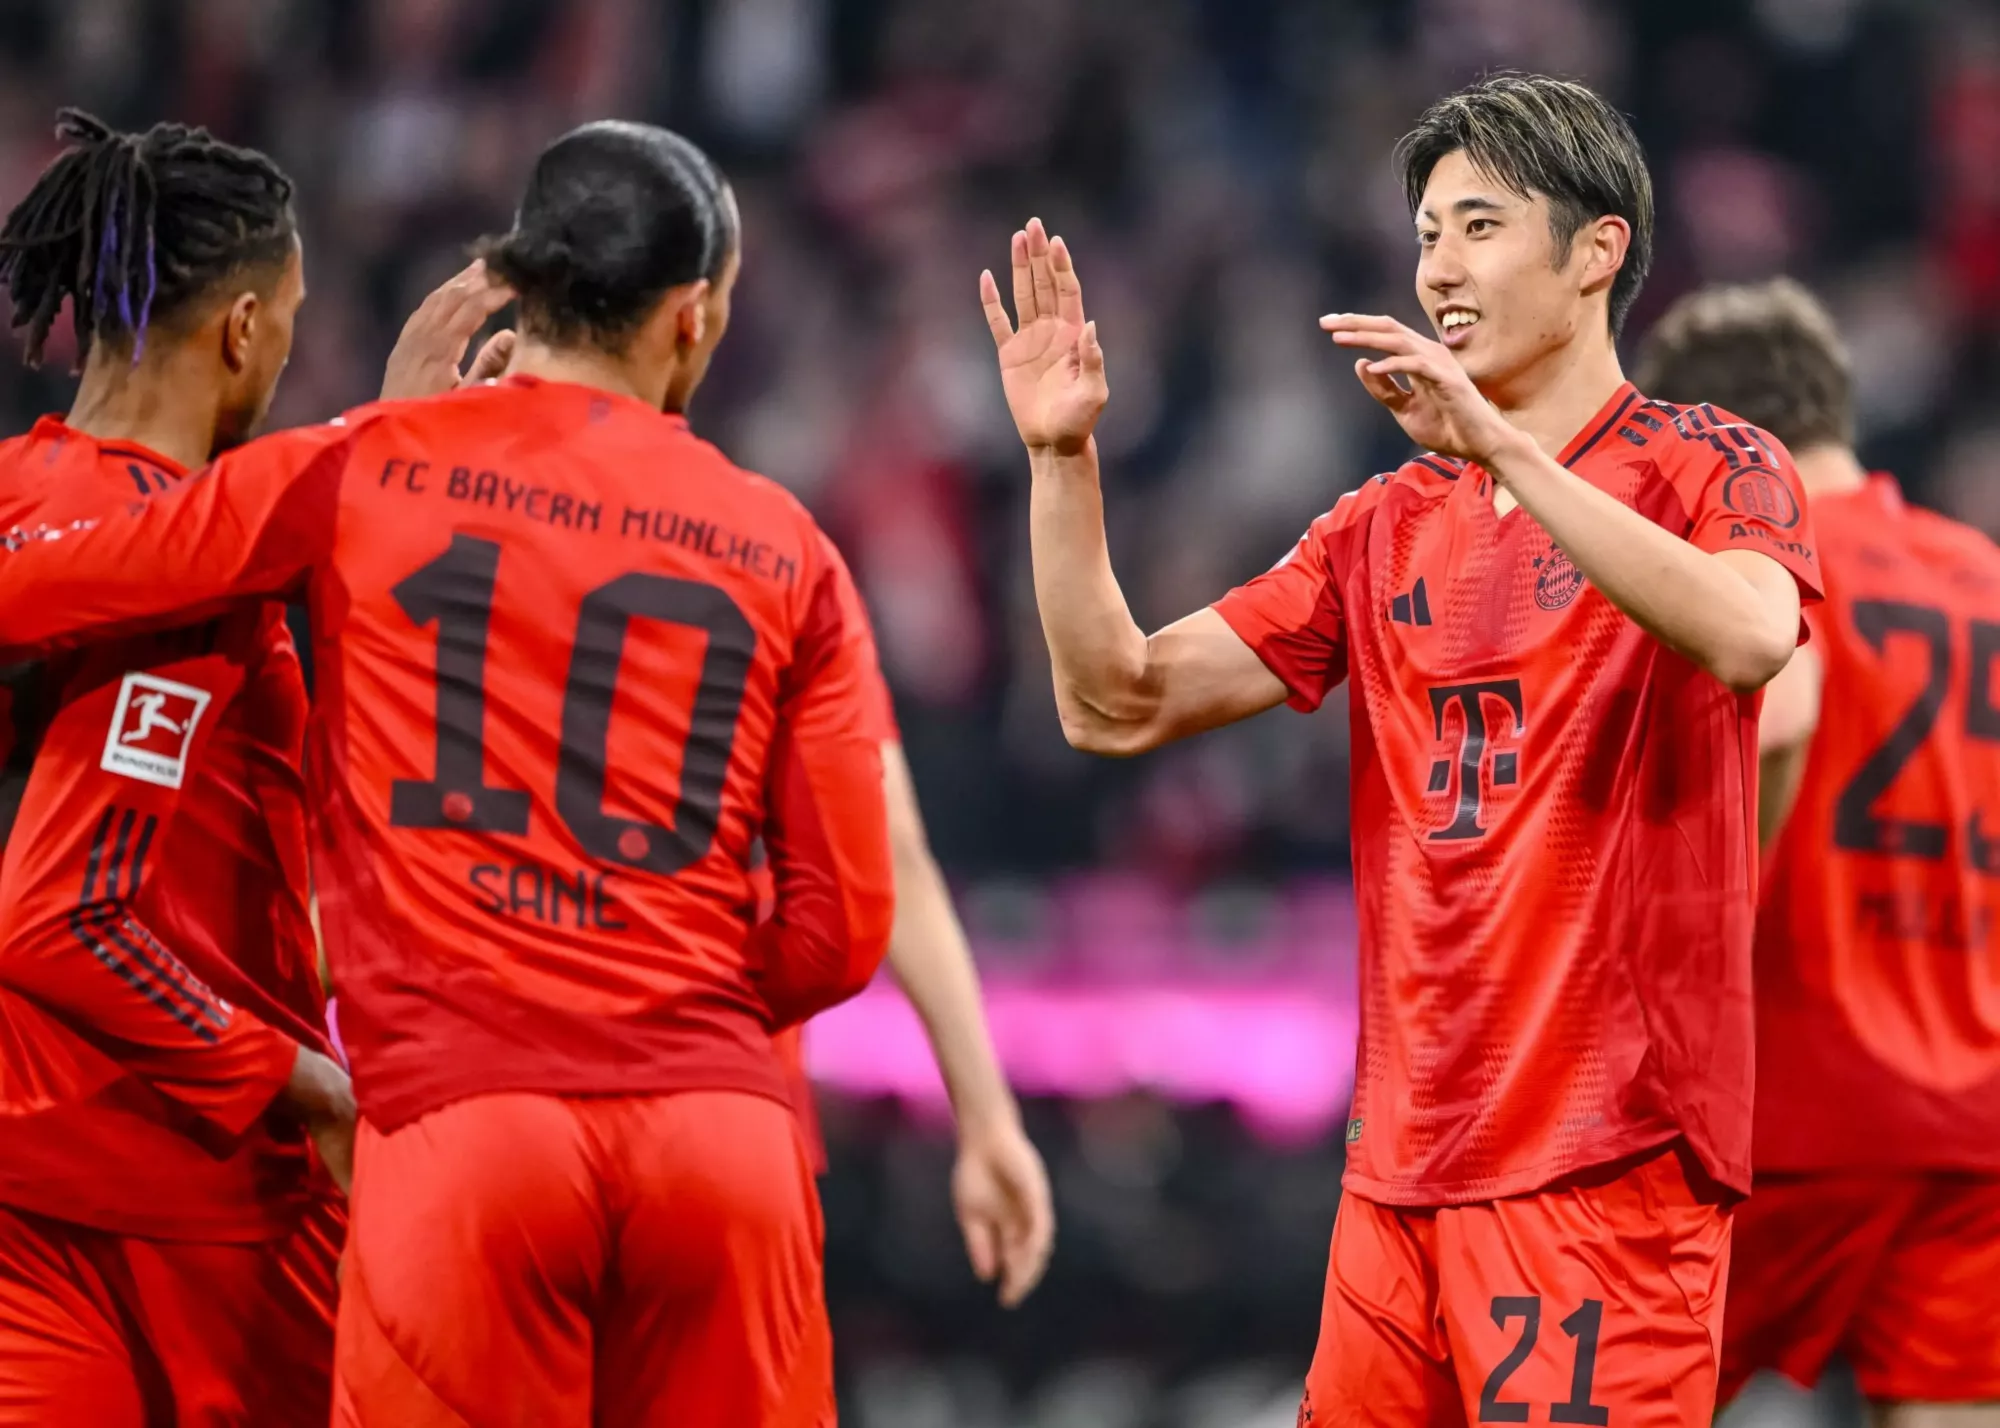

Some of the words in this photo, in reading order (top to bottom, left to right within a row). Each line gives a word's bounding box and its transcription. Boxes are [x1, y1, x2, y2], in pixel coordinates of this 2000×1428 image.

[380, 458, 430, 493] FC
[447, 466, 602, 533] BAYERN
[390, 533, 757, 877] 10
[1479, 1296, 1609, 1427] 21
